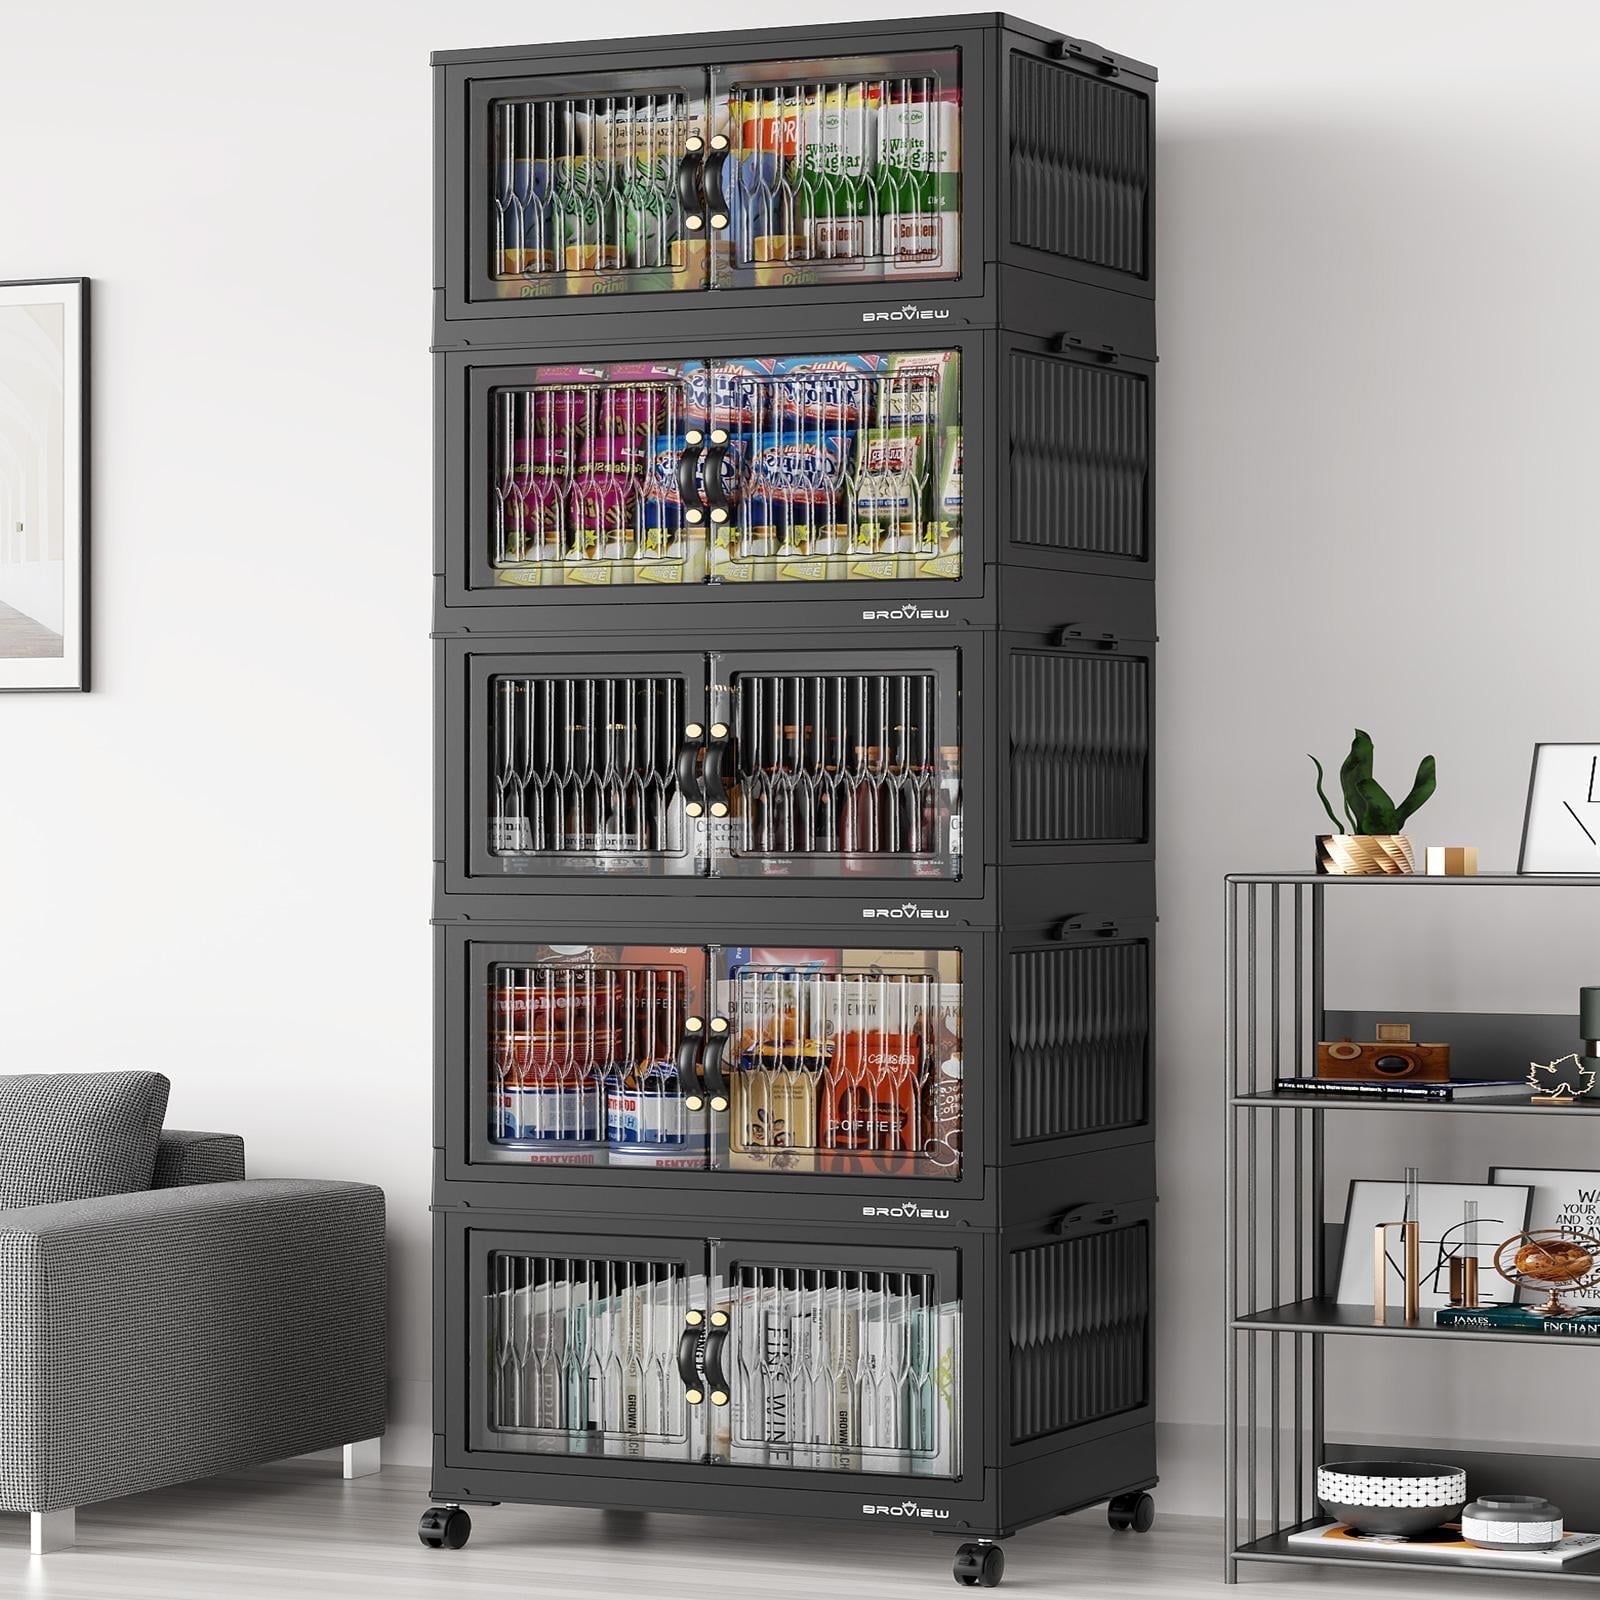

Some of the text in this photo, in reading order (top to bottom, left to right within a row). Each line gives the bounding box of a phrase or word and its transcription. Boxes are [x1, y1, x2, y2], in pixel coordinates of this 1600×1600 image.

[863, 309, 949, 321] BROVIEW
[863, 607, 949, 619] BROVIEW
[863, 906, 949, 918] BROVIEW
[829, 1119, 903, 1132] COFFEE
[863, 1205, 949, 1218] BROVIEW
[1563, 1204, 1596, 1214] YOUR
[1556, 1215, 1581, 1224] AND
[1454, 1315, 1489, 1324] JAMES
[628, 1394, 637, 1429] GROWN
[839, 1410, 848, 1444] GROWN
[863, 1505, 949, 1518] BROVIEW
